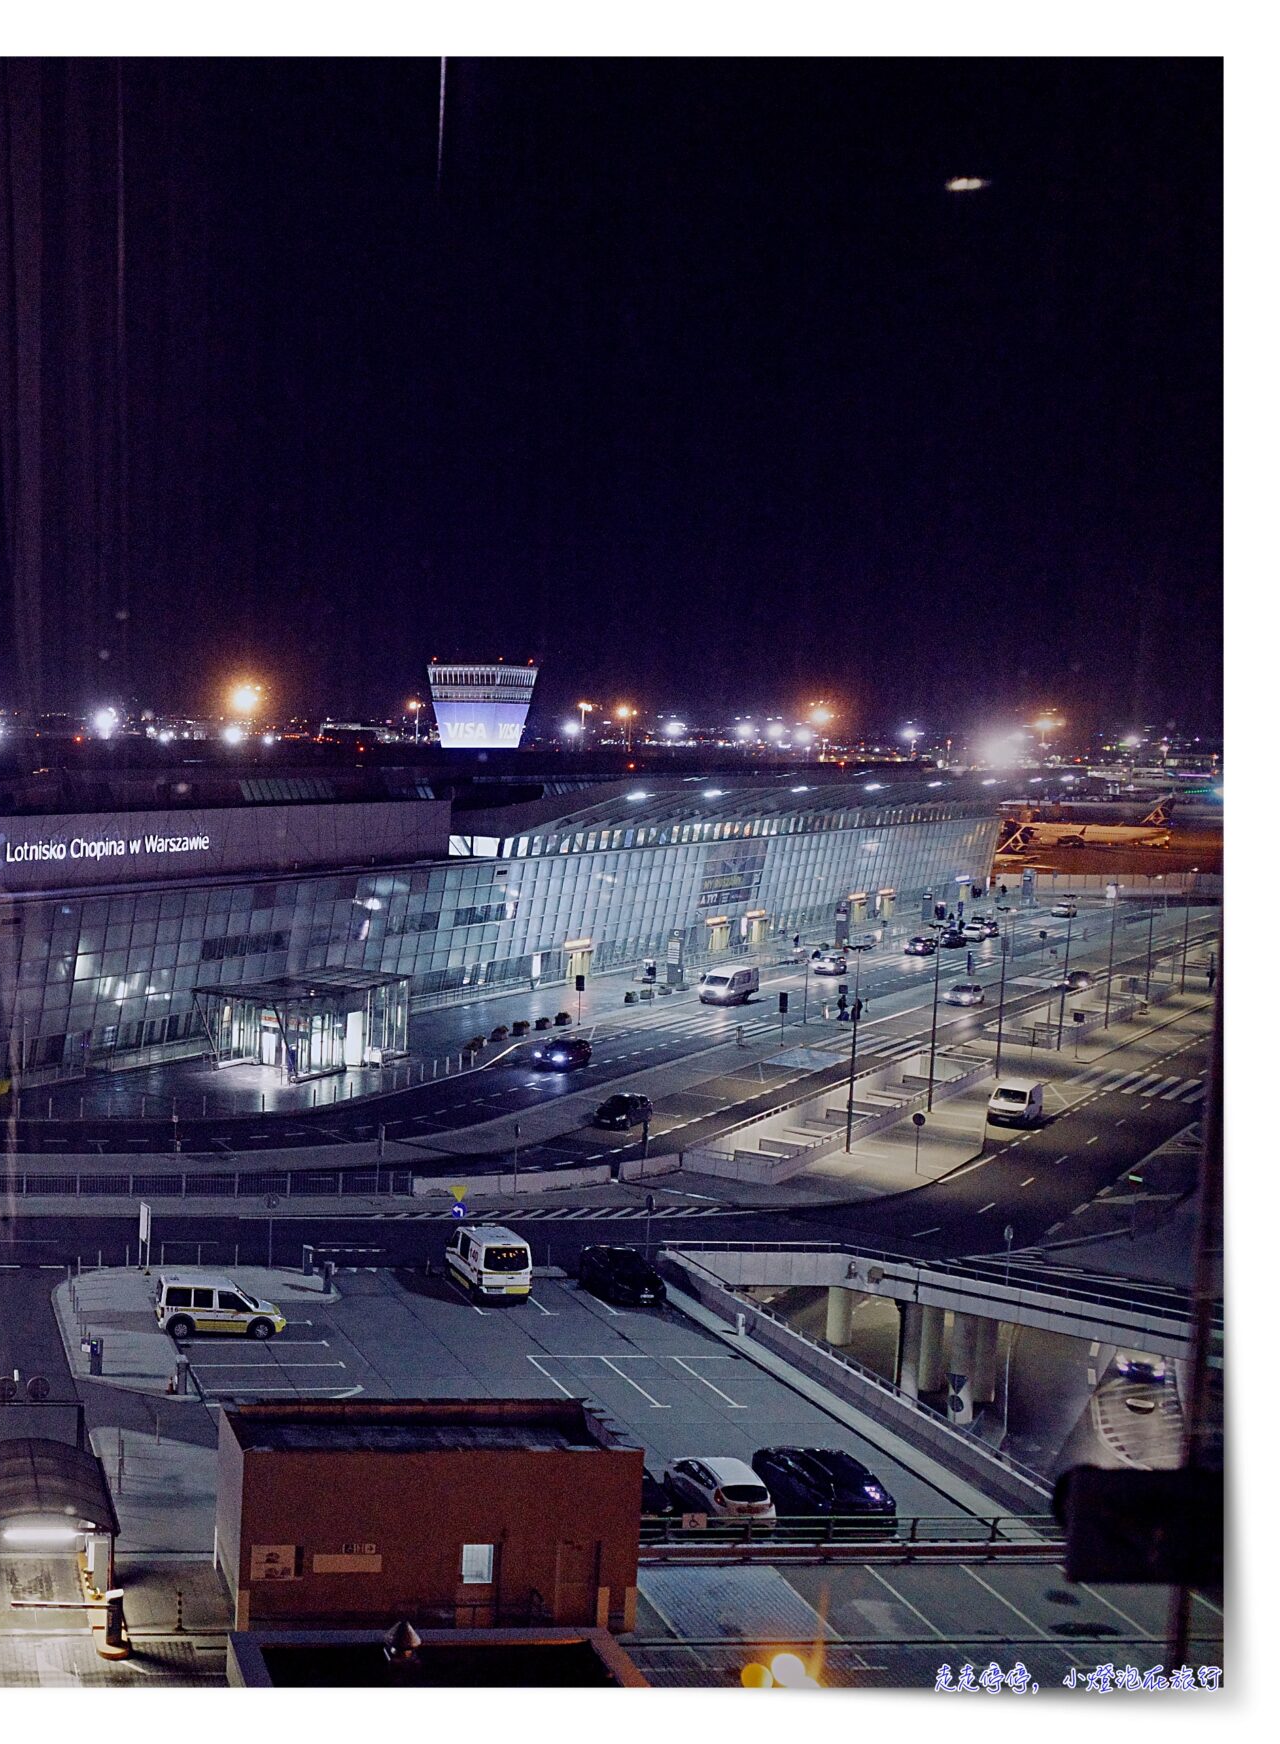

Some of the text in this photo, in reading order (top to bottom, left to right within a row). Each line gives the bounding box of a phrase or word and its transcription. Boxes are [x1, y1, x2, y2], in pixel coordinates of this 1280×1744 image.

[443, 721, 487, 739] VISA
[6, 833, 209, 862] Lotnisko Chopina w Warszawie
